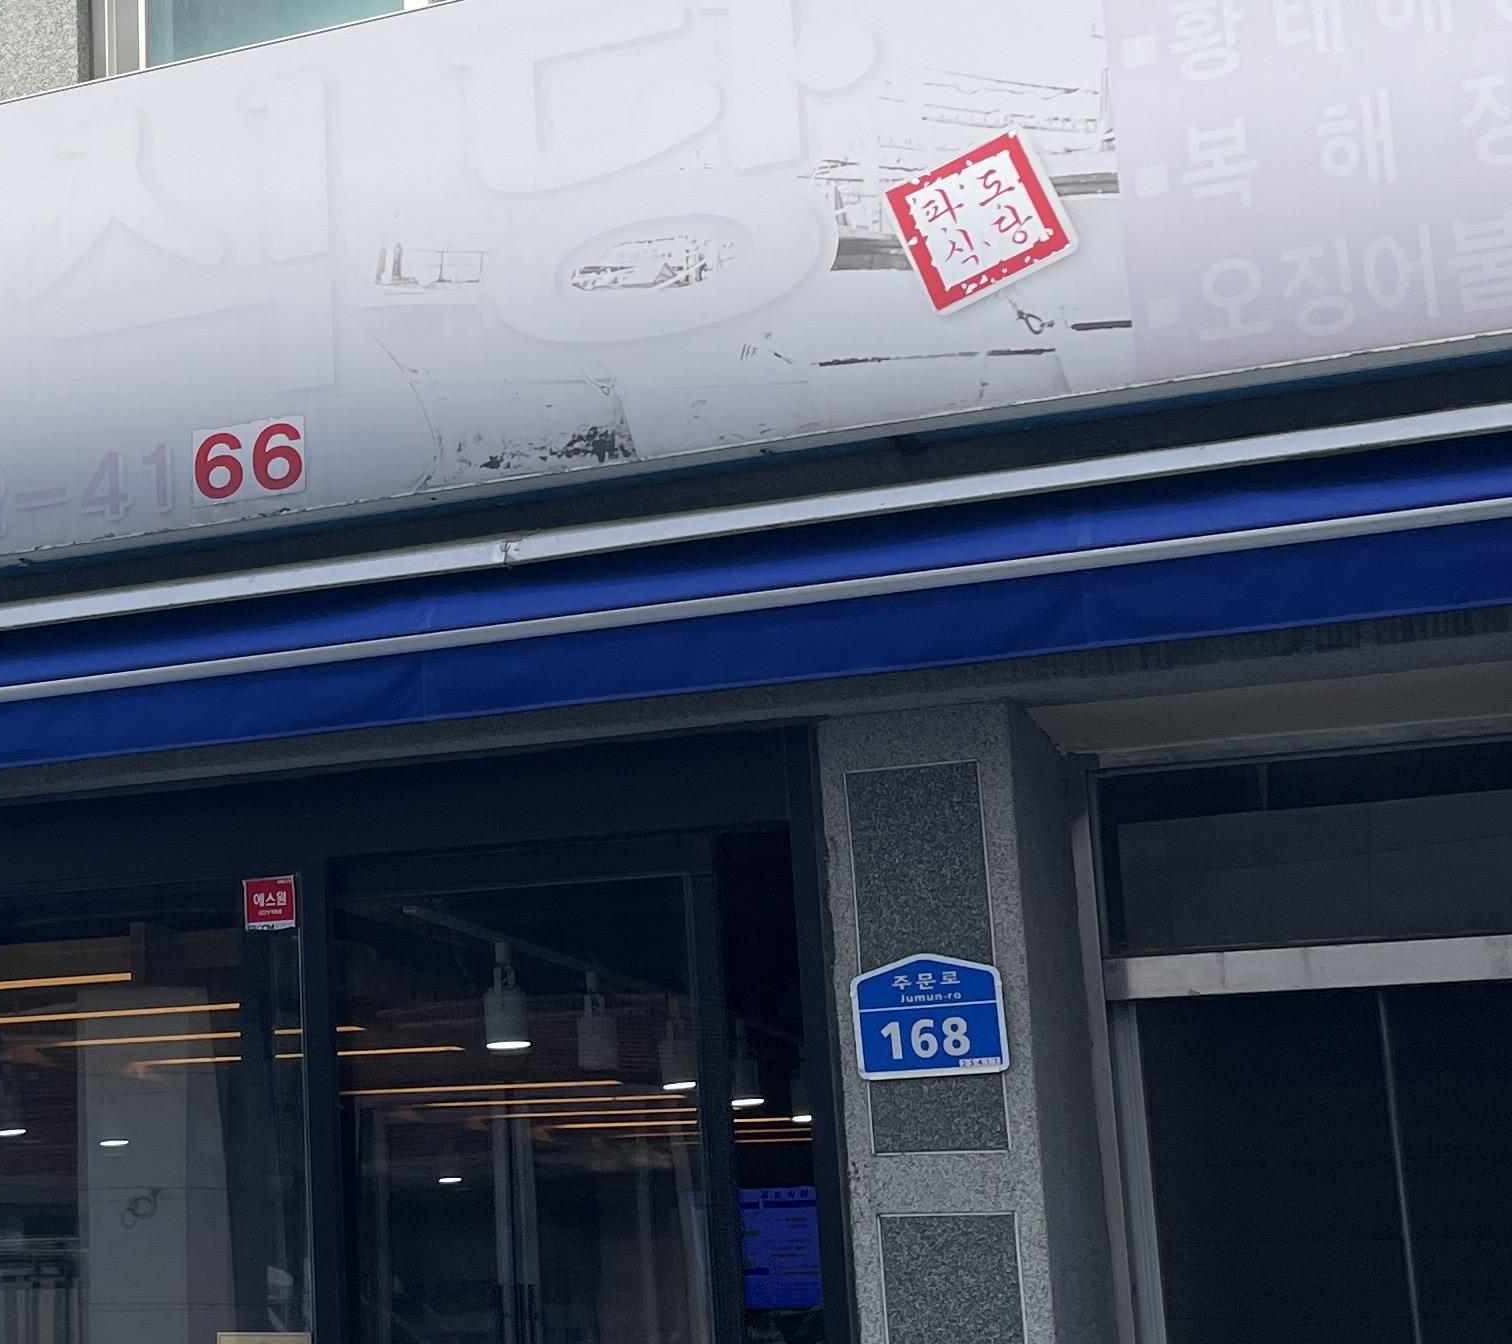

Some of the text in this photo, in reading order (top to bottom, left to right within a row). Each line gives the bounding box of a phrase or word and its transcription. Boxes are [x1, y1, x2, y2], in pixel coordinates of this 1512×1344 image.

[253, 891, 287, 907] 에스원
[891, 970, 961, 990] 주문로
[900, 991, 962, 1003] Jumun-ro
[880, 1016, 971, 1060] 168
